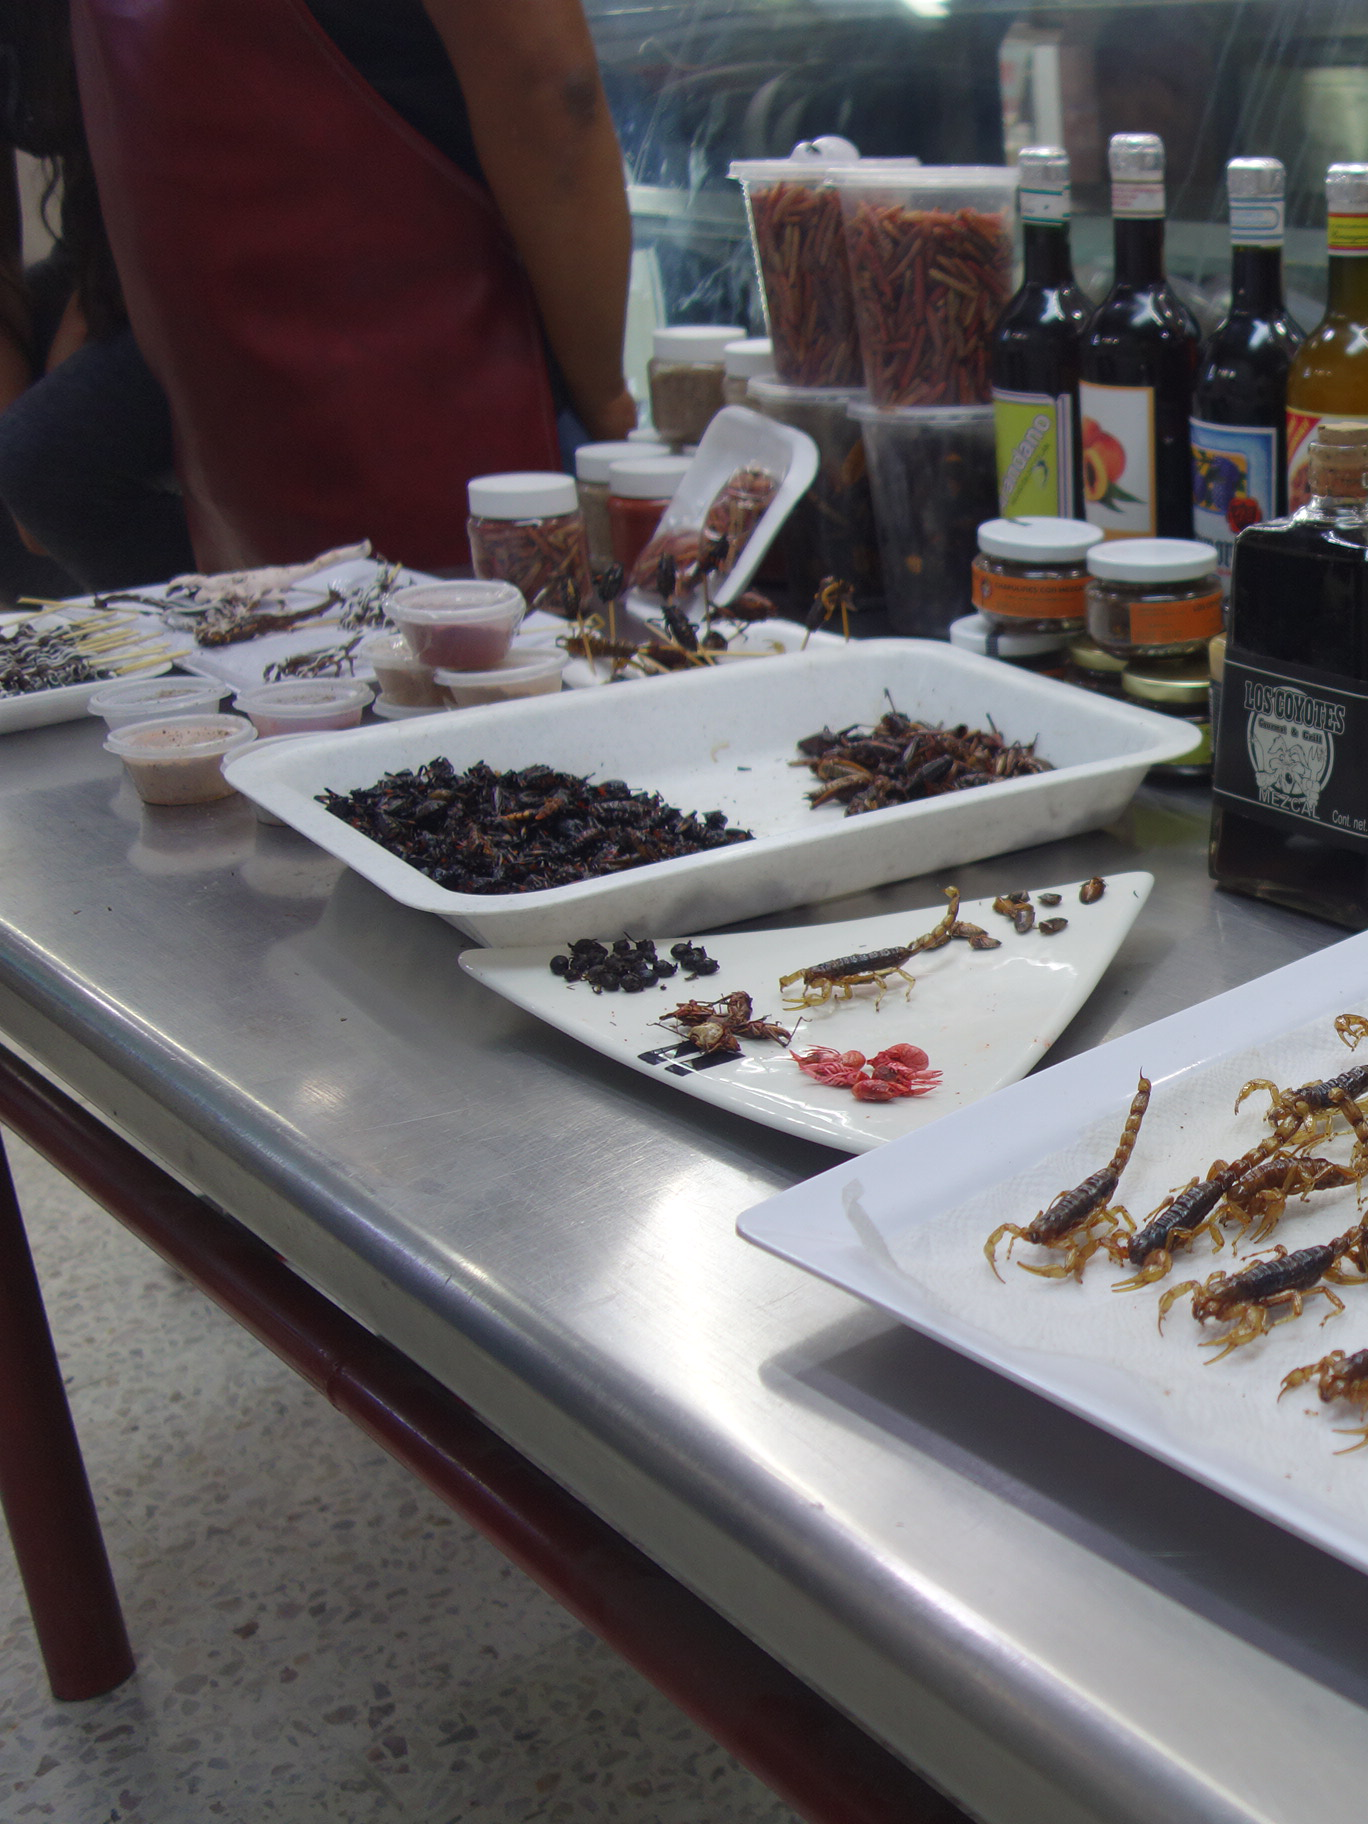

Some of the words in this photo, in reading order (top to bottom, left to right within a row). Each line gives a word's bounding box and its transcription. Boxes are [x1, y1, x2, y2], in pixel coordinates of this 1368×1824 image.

[1243, 680, 1274, 716] LOS
[1272, 687, 1346, 736] COYOTES
[1258, 786, 1321, 820] MEZCAL
